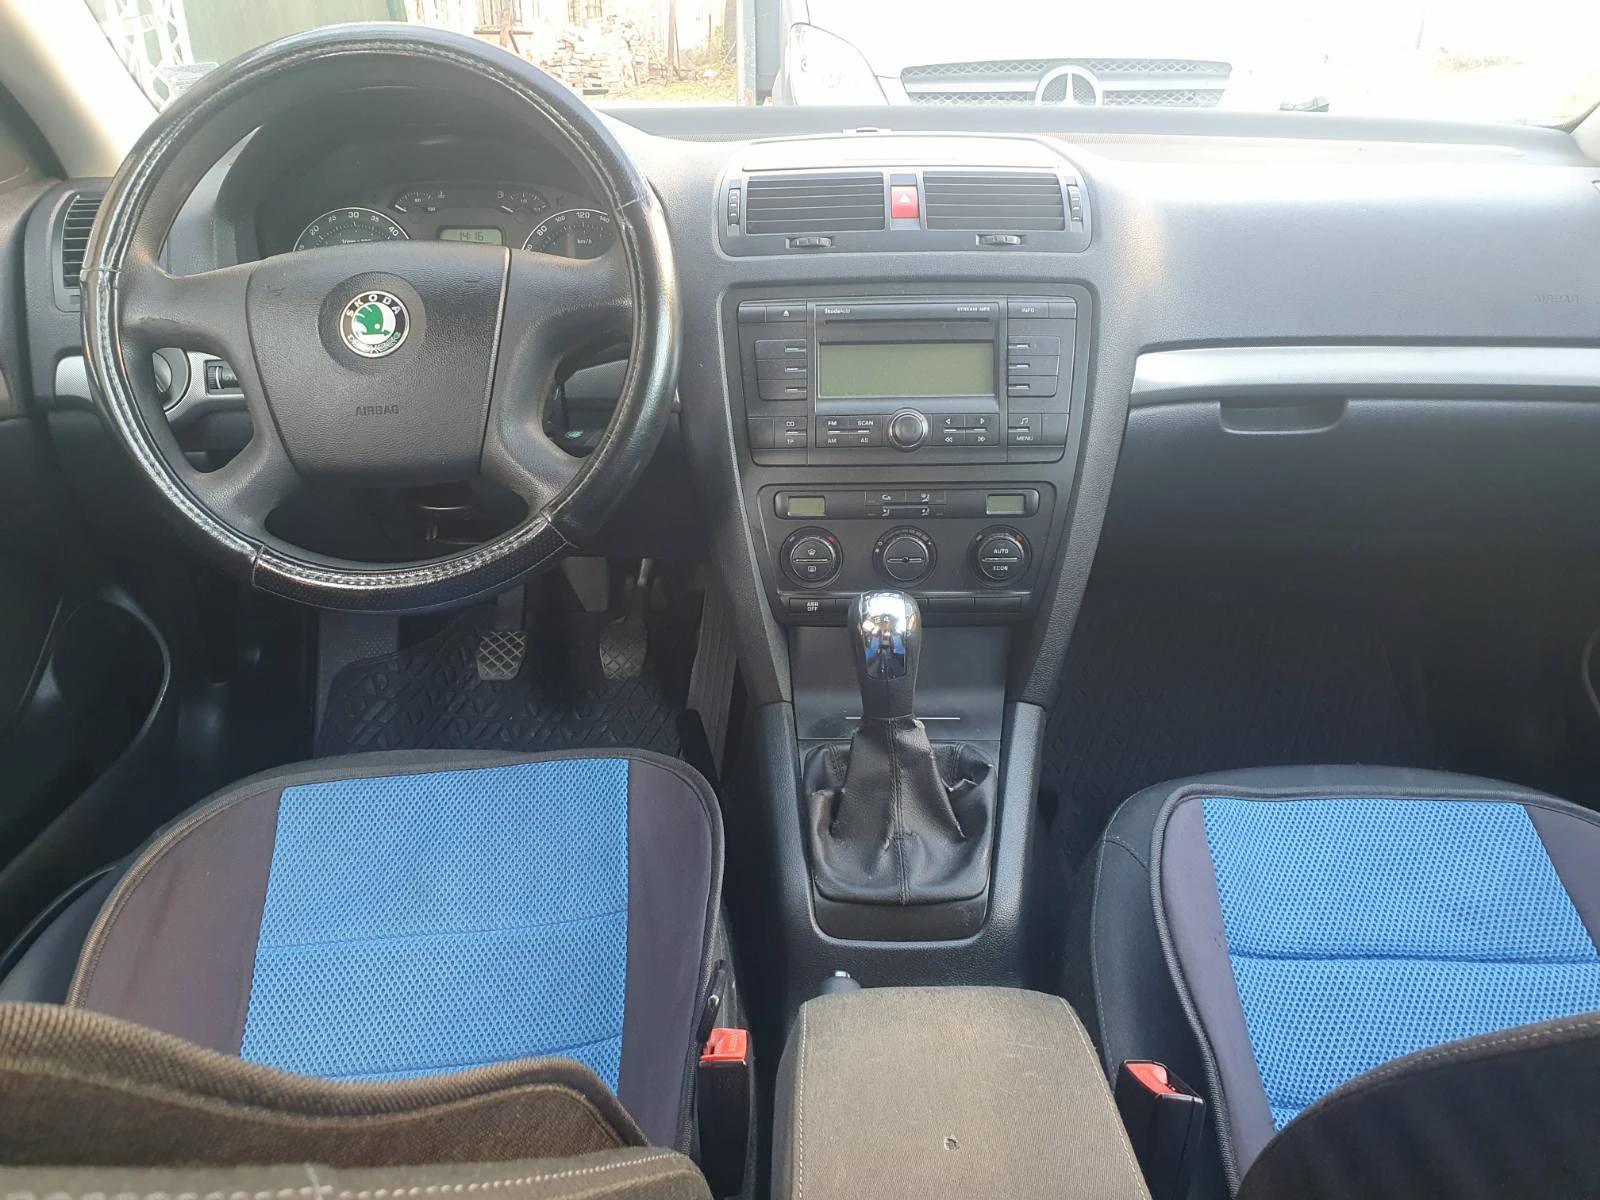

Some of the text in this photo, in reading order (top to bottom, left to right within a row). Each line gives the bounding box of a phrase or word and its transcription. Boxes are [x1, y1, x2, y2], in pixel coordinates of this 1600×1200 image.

[328, 215, 337, 223] 25
[348, 211, 360, 219] 30
[370, 215, 379, 223] 35
[576, 211, 591, 219] 120
[309, 225, 320, 236] 20
[388, 225, 399, 237] 40
[536, 225, 548, 237] 80
[459, 231, 484, 241] 14:16
[355, 404, 400, 417] AIRBAG
